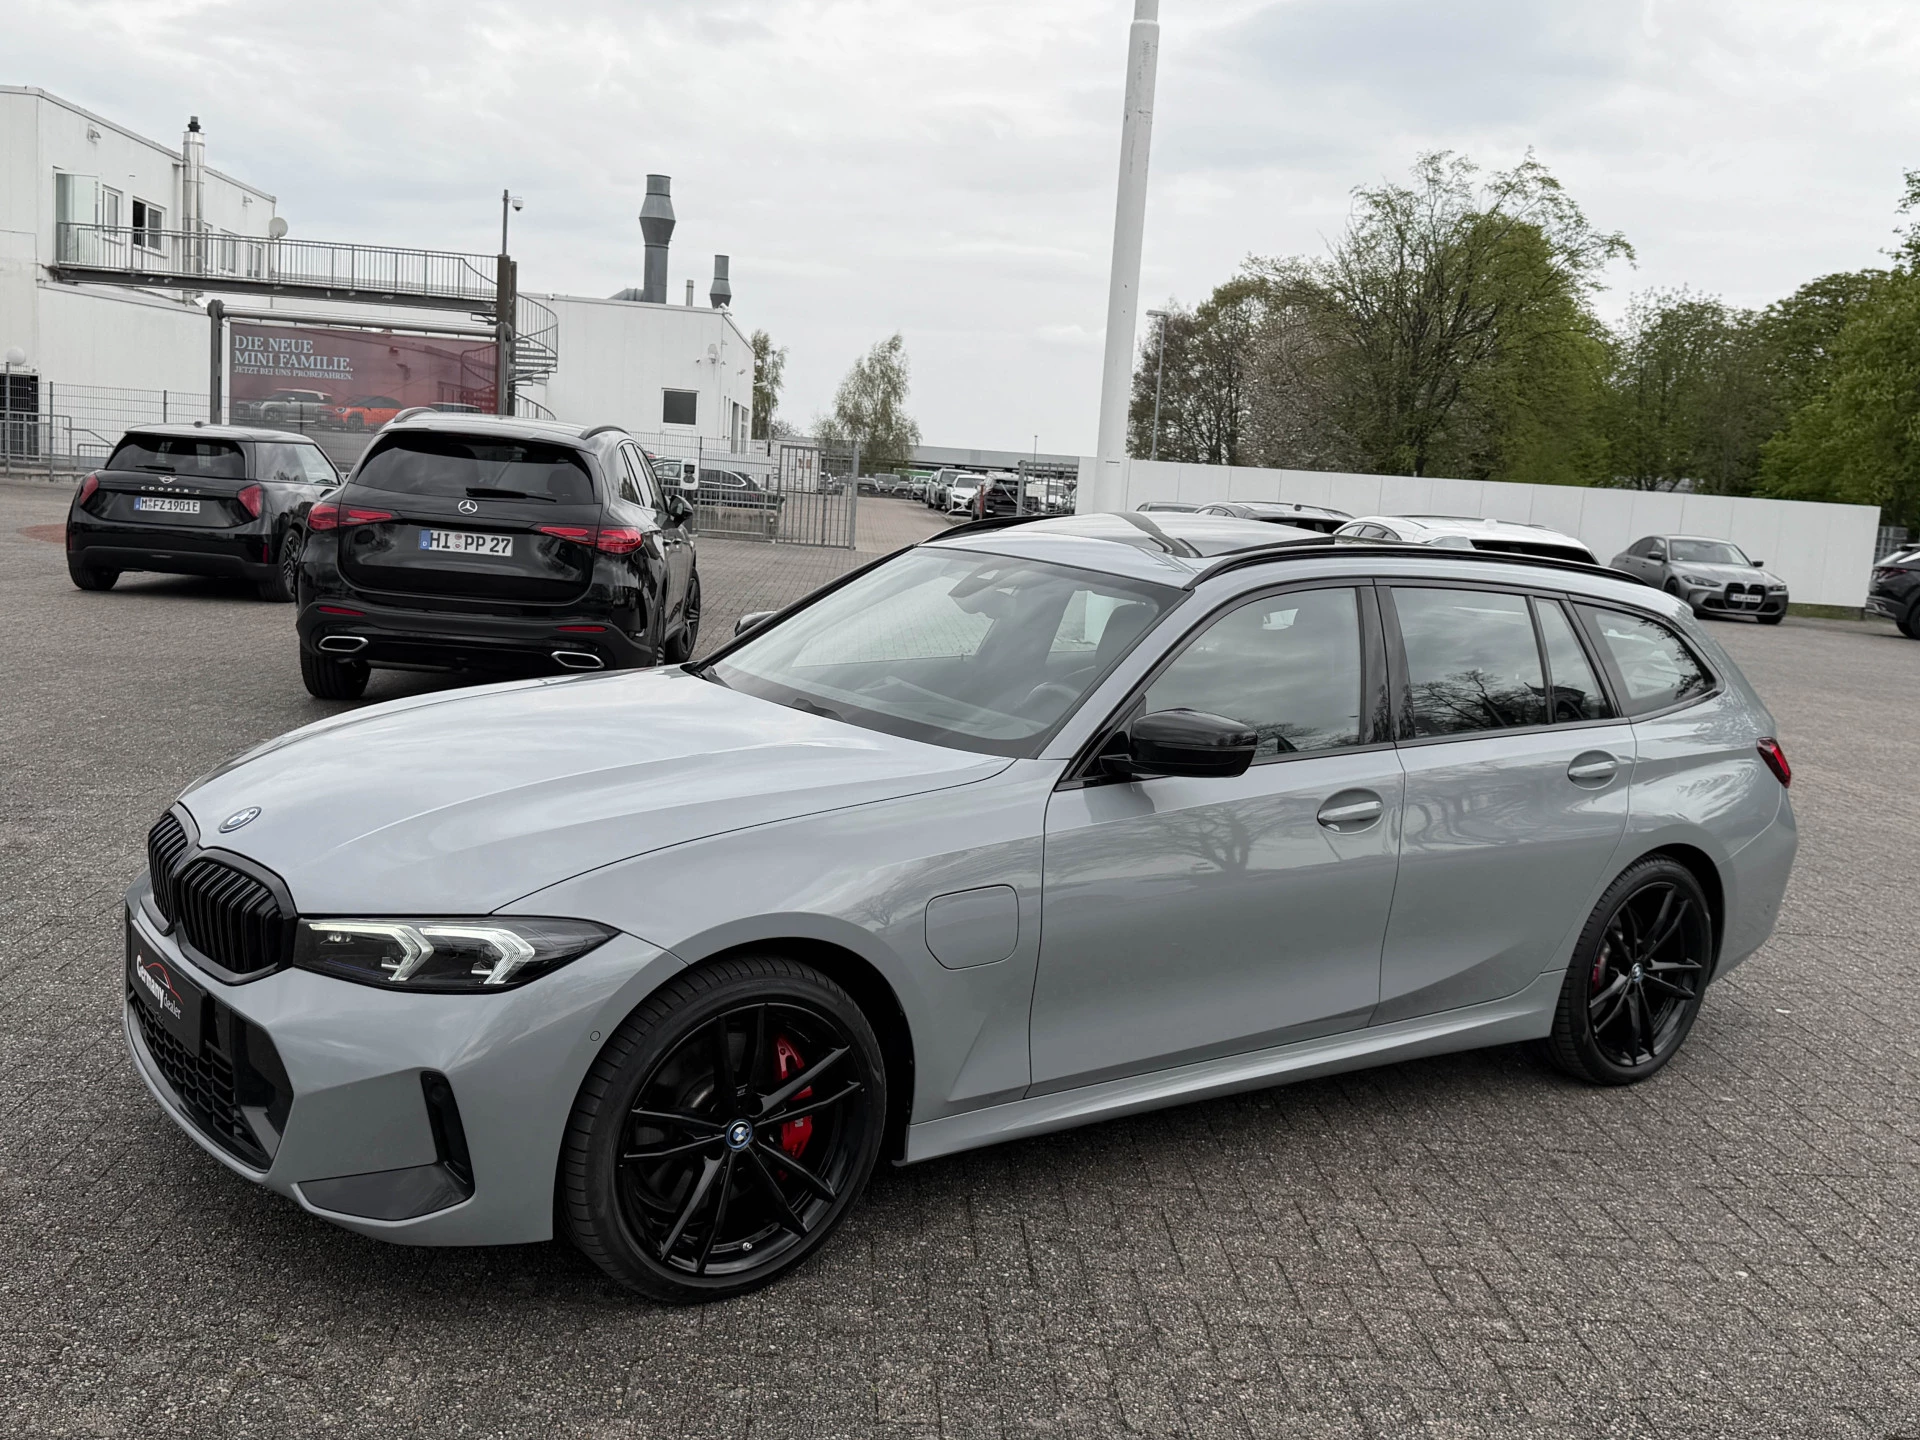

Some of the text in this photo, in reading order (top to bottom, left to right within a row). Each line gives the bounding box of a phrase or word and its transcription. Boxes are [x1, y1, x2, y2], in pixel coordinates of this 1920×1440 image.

[234, 335, 313, 354] DIE NEUE
[234, 351, 353, 371] MINI FAMILIE.
[234, 366, 259, 374] JETZT
[275, 368, 292, 377] UNS
[430, 532, 511, 553] HI PP 27
